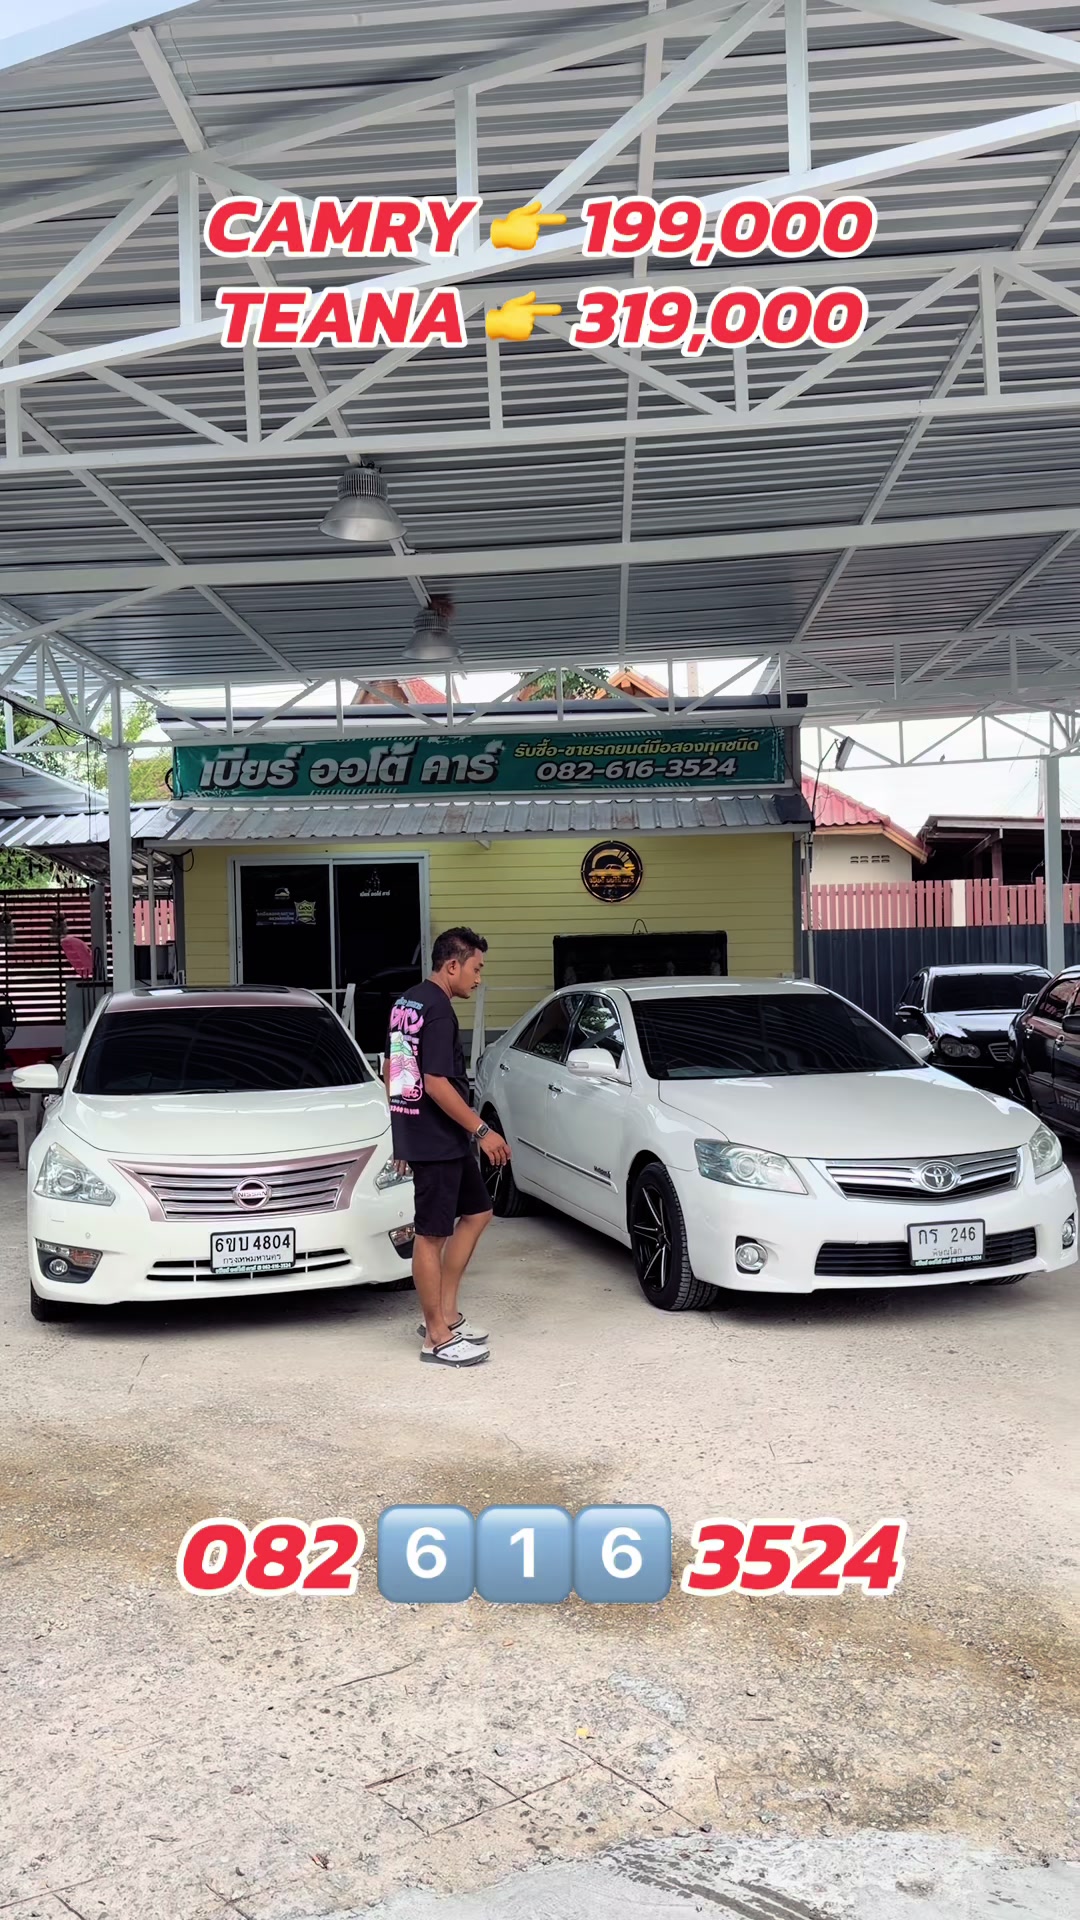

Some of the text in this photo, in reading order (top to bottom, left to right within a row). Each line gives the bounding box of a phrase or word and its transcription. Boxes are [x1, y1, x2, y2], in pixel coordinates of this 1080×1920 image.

[514, 738, 759, 758] รับซื้อ-ขายรถยนต์มือสองทุกชนิด
[200, 740, 505, 787] เบียร์ ออโต้ คาร์
[536, 757, 737, 781] 082-616-3524
[237, 1190, 268, 1198] NISSAN
[215, 1234, 291, 1253] 6ขบ 4804
[918, 1226, 977, 1245] กร 246
